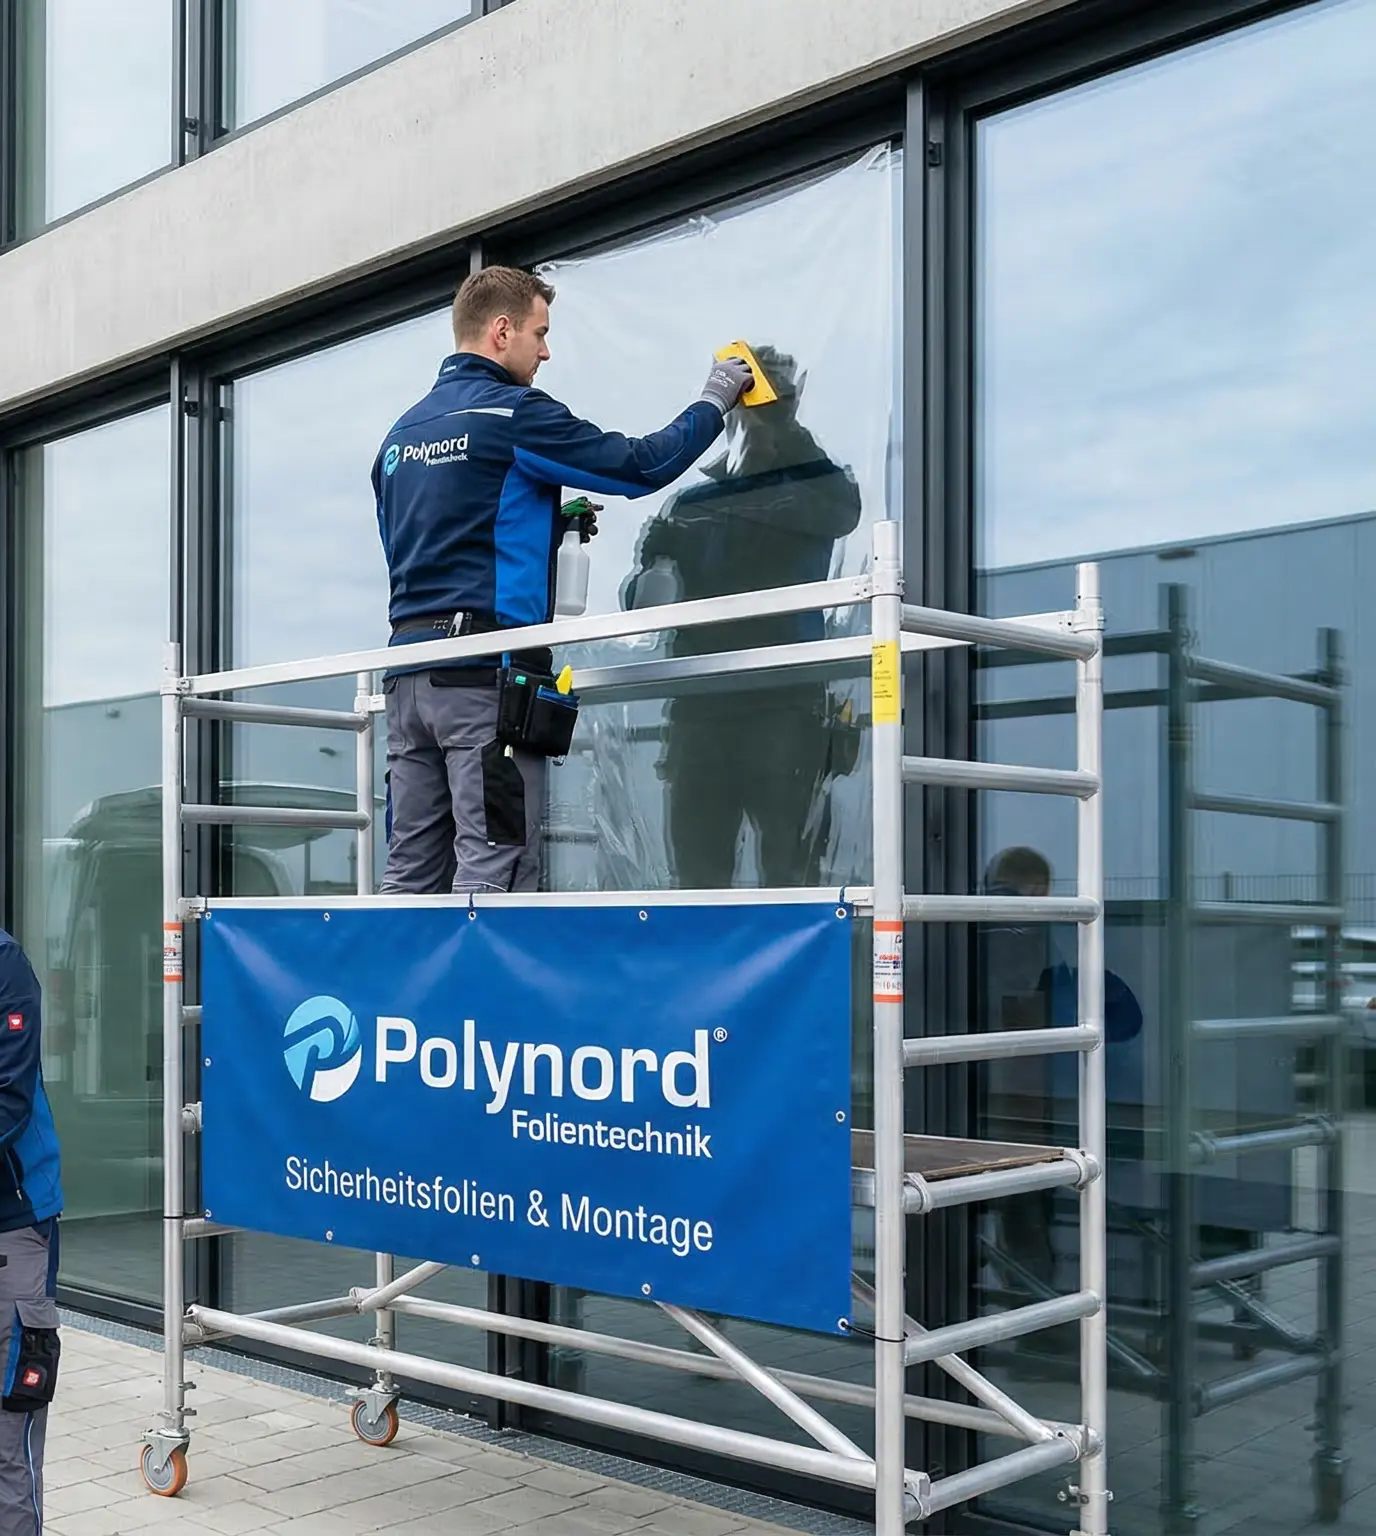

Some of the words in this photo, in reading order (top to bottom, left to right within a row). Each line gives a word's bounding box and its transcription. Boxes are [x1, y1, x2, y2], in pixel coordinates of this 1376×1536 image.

[403, 433, 469, 464] Polynord
[511, 1109, 713, 1158] Folientechnik
[285, 1155, 516, 1223] Sicherheitsfolien
[526, 1190, 550, 1228] &
[561, 1194, 714, 1258] Montage
